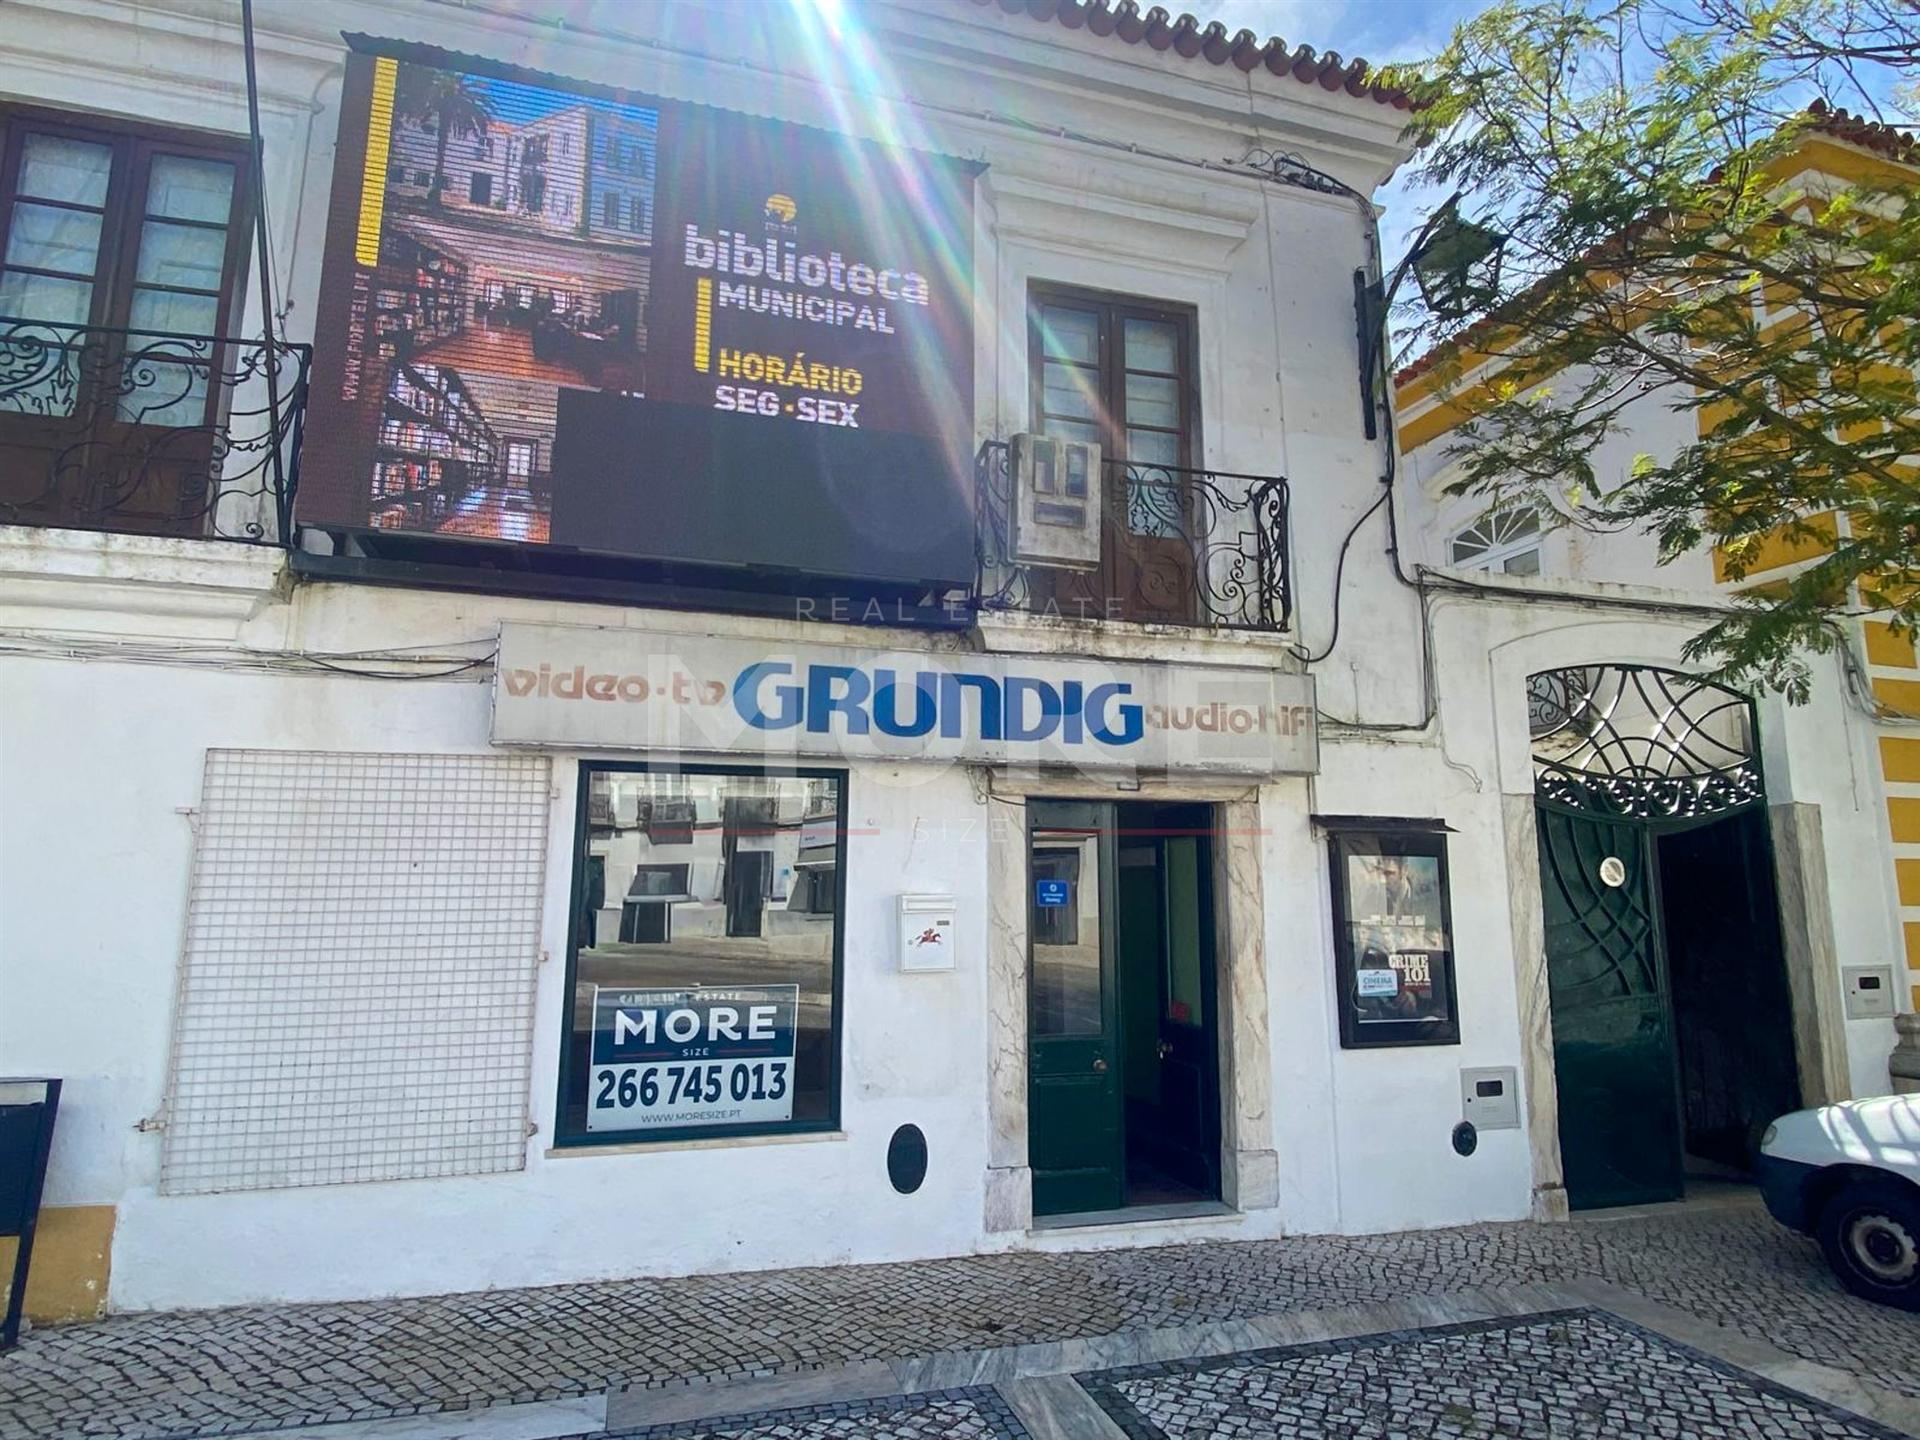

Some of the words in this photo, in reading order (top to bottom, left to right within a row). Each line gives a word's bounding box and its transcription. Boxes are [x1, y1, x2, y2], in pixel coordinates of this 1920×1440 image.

[684, 224, 930, 306] biblioteca
[718, 282, 895, 335] MUNICIPAL
[717, 351, 863, 395] HORÁRIO
[732, 661, 1144, 746] GRUNDIG
[1404, 967, 1431, 982] 101
[614, 1006, 776, 1045] MORE
[682, 1047, 709, 1057] SIZE
[596, 1067, 659, 1109] 266
[667, 1065, 722, 1104] 745
[730, 1062, 786, 1101] 013
[641, 1109, 742, 1123] WWW.MORESIZE.PT
